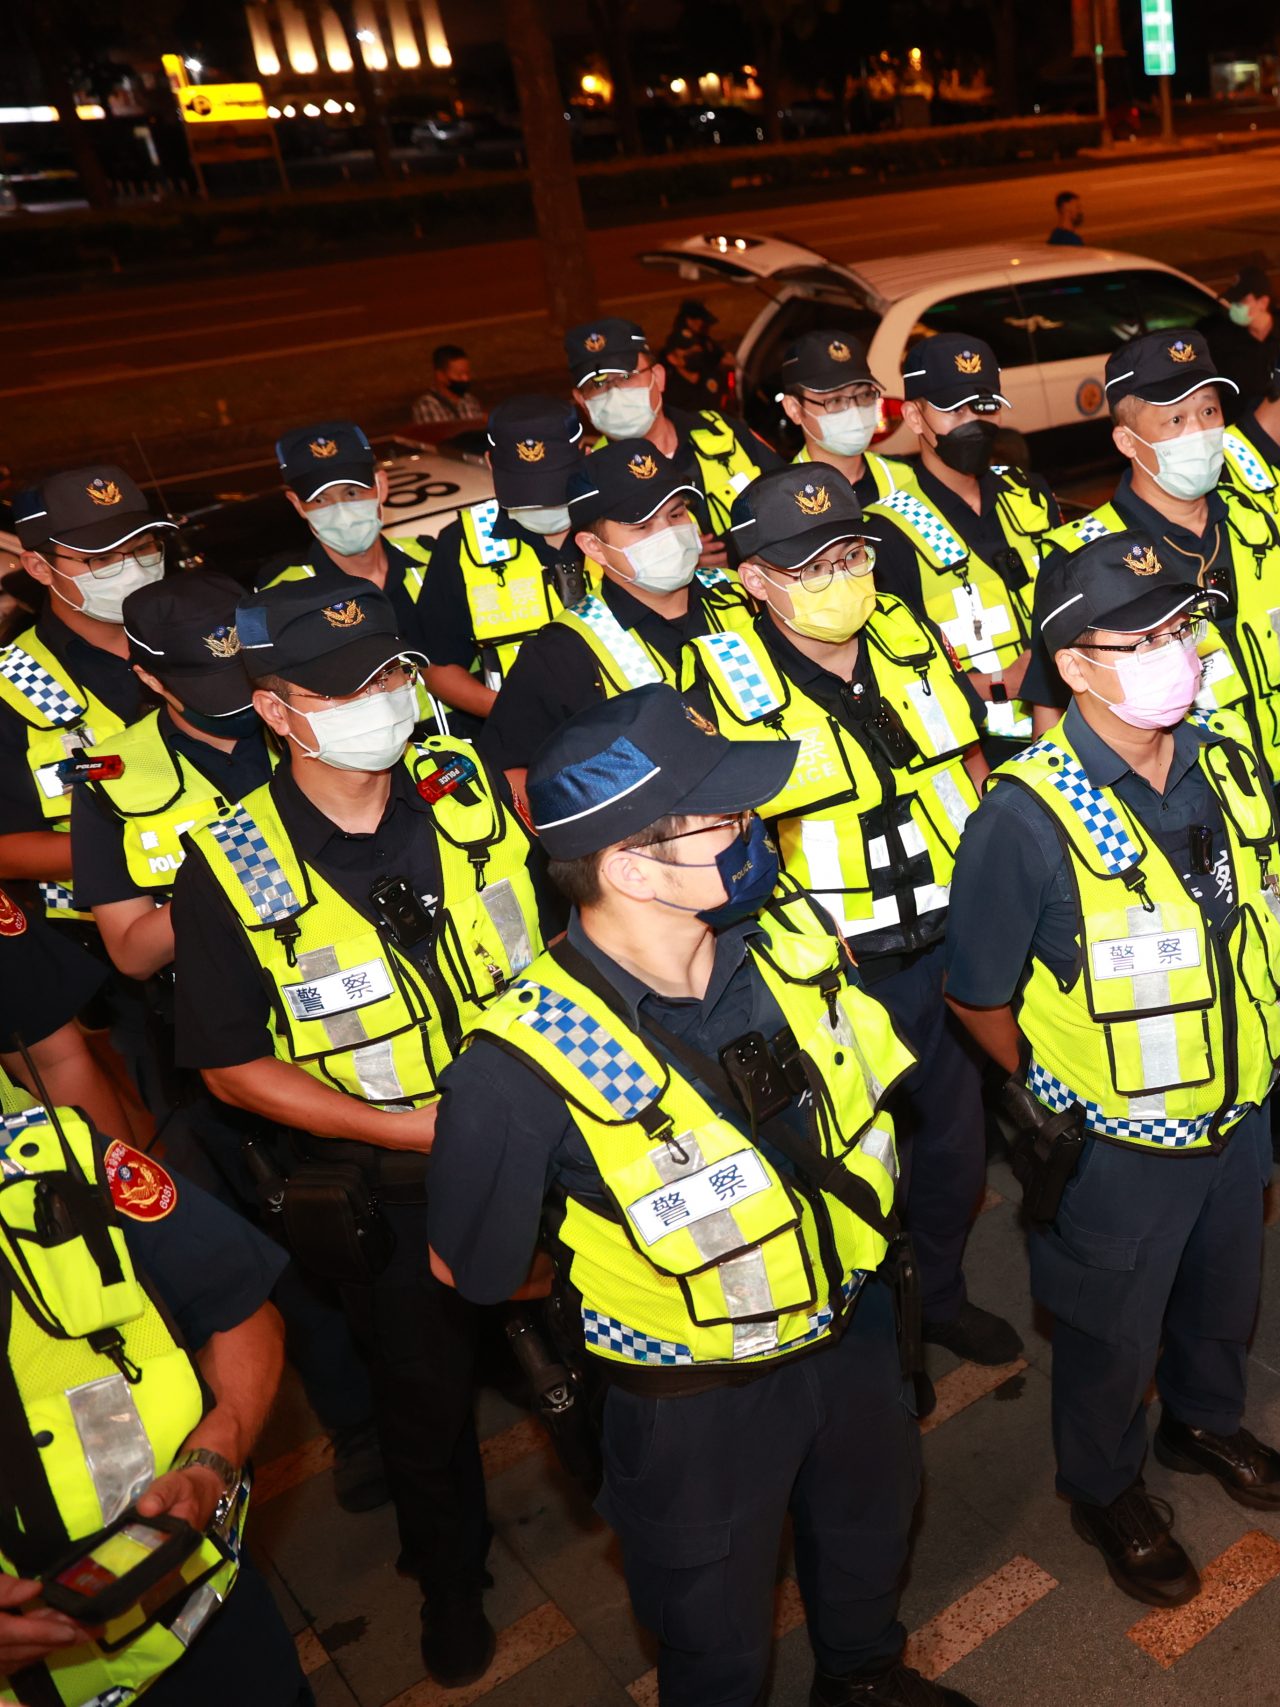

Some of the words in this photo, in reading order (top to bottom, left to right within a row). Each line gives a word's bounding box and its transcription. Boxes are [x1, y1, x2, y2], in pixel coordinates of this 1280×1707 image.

[75, 762, 103, 770] POLICE
[438, 767, 461, 786] POLICE
[784, 761, 839, 791] ICE
[1110, 938, 1183, 973] 警察
[296, 971, 374, 1014] 警察
[652, 1163, 748, 1227] 警察
